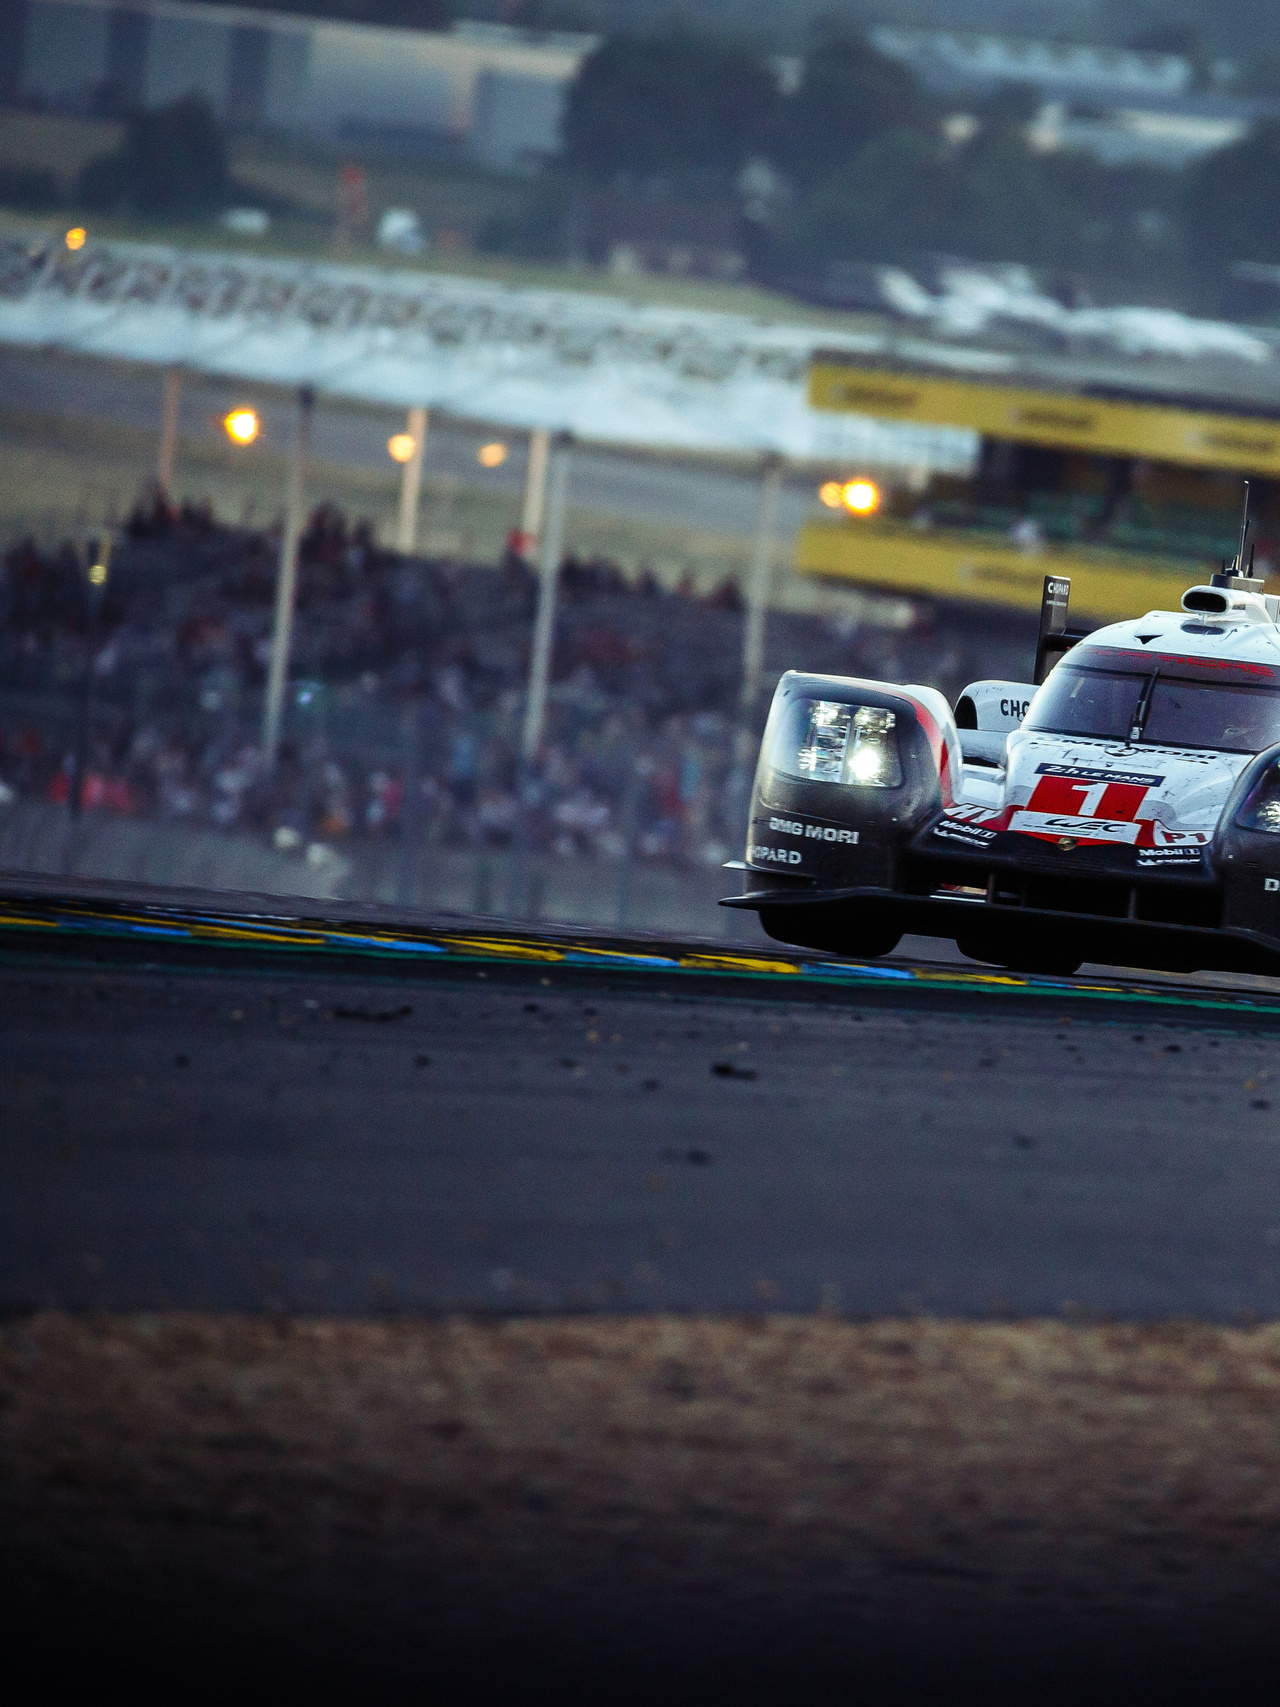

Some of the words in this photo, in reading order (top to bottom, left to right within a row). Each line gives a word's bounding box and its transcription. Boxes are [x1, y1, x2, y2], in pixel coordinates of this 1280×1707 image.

[1104, 773, 1155, 783] MANS
[1071, 782, 1110, 816] 1
[939, 820, 983, 835] Mobil
[1044, 818, 1127, 833] WEC
[804, 825, 860, 844] MORI
[1161, 830, 1208, 844] P1
